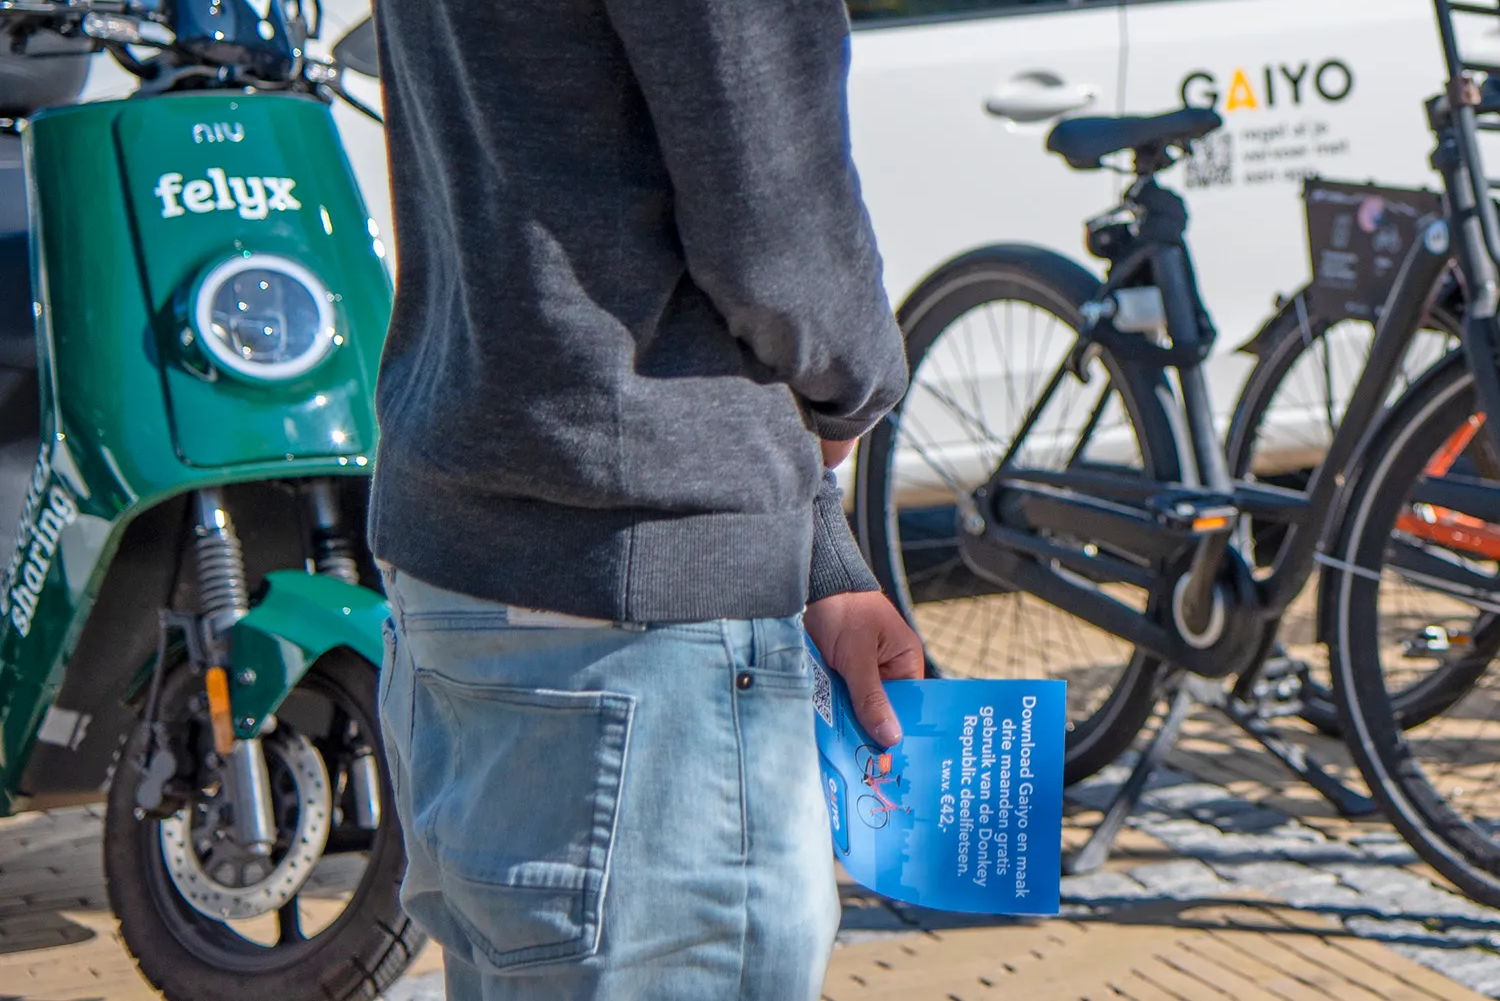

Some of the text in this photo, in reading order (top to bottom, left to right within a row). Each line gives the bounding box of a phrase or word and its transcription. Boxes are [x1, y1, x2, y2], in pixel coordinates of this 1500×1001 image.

[1179, 58, 1353, 113] GAIYO
[155, 167, 301, 220] felyx
[11, 486, 77, 638] sharing
[937, 793, 955, 833] €42,-
[957, 715, 977, 877] Republic deelfietsen.
[972, 706, 996, 887] gebruik van de Donkey
[994, 718, 1017, 876] drie maanden gratis
[1014, 696, 1037, 898] Download Gaiyo en maak
